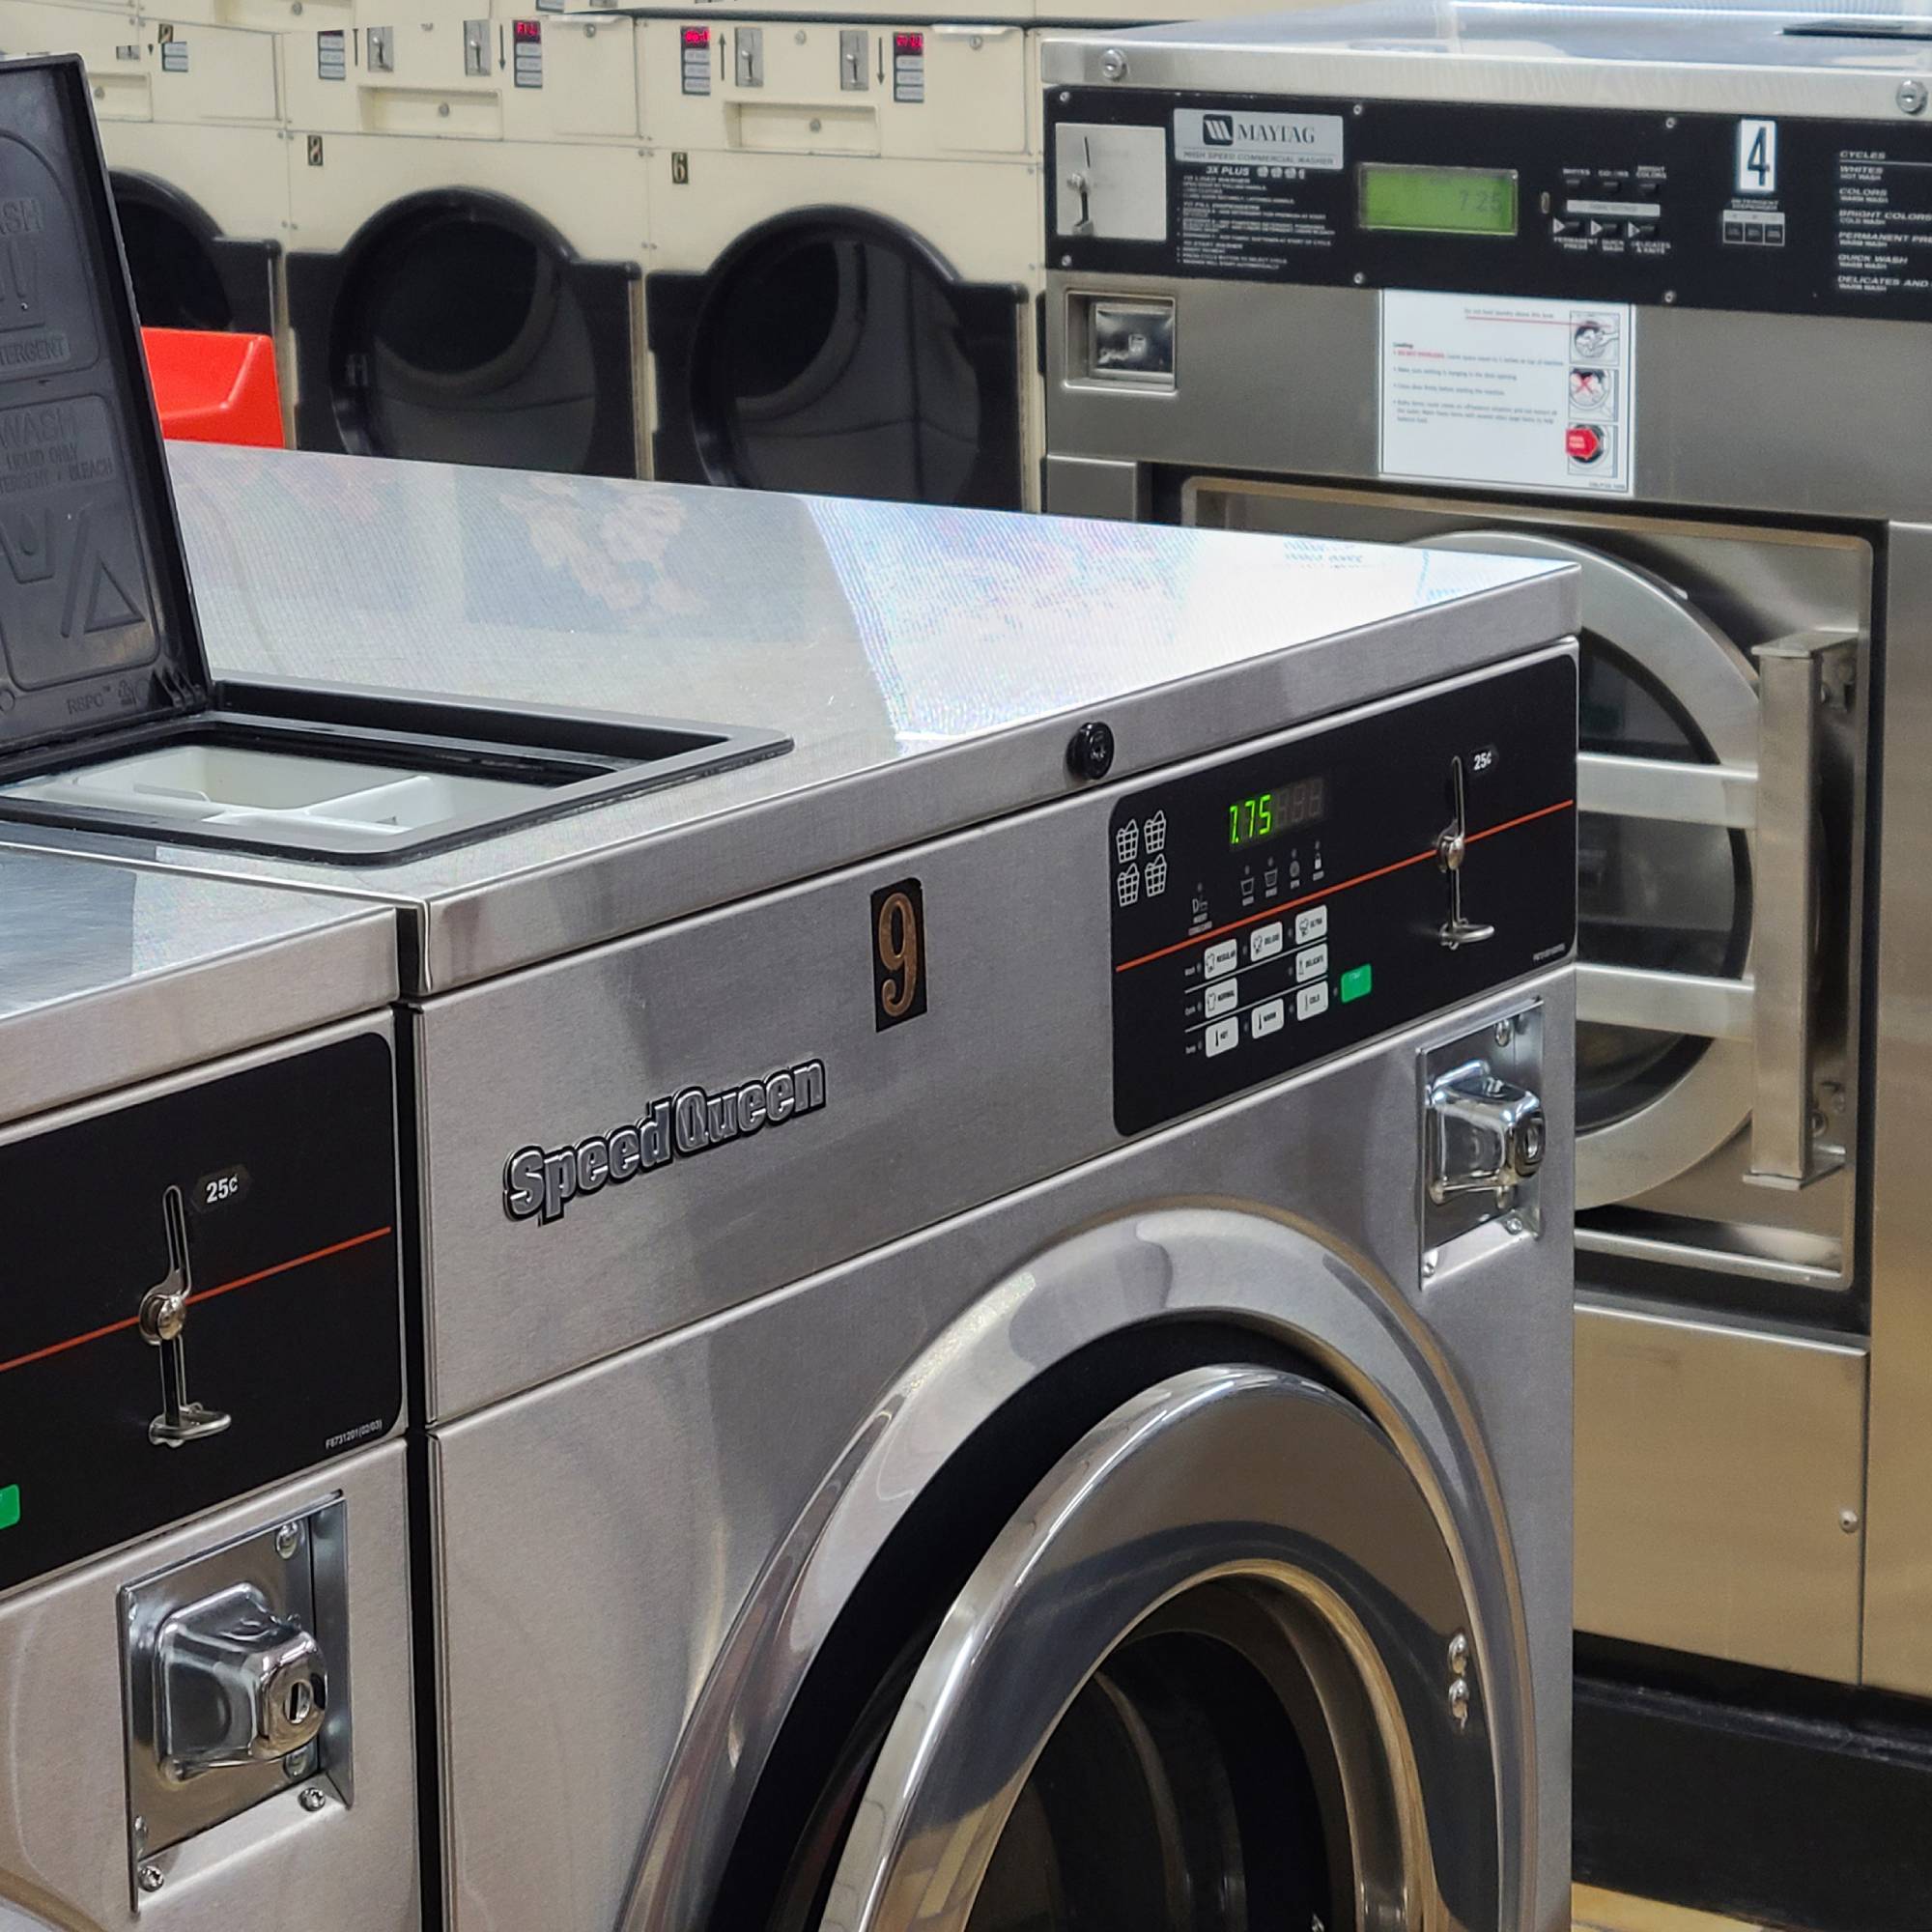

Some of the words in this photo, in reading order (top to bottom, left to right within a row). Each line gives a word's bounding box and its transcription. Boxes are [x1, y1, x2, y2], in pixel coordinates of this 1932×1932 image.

[1237, 124, 1315, 144] MAYTAG
[1747, 127, 1771, 186] 4
[1839, 150, 1887, 160] CYCLES
[672, 154, 688, 184] 6
[1221, 166, 1250, 177] PLUS
[1838, 187, 1889, 197] COLORS
[1838, 210, 1882, 219] BRIGHT
[1838, 231, 1910, 242] PERMANENT
[1875, 255, 1909, 265] WASH
[1837, 275, 1900, 287] DELICATES
[1903, 278, 1930, 288] AND
[68, 457, 114, 481] BLEACH
[878, 892, 918, 1018] 9
[503, 1096, 674, 1227] Speed
[673, 1059, 827, 1157] Queen
[206, 1173, 240, 1204] 25¢
